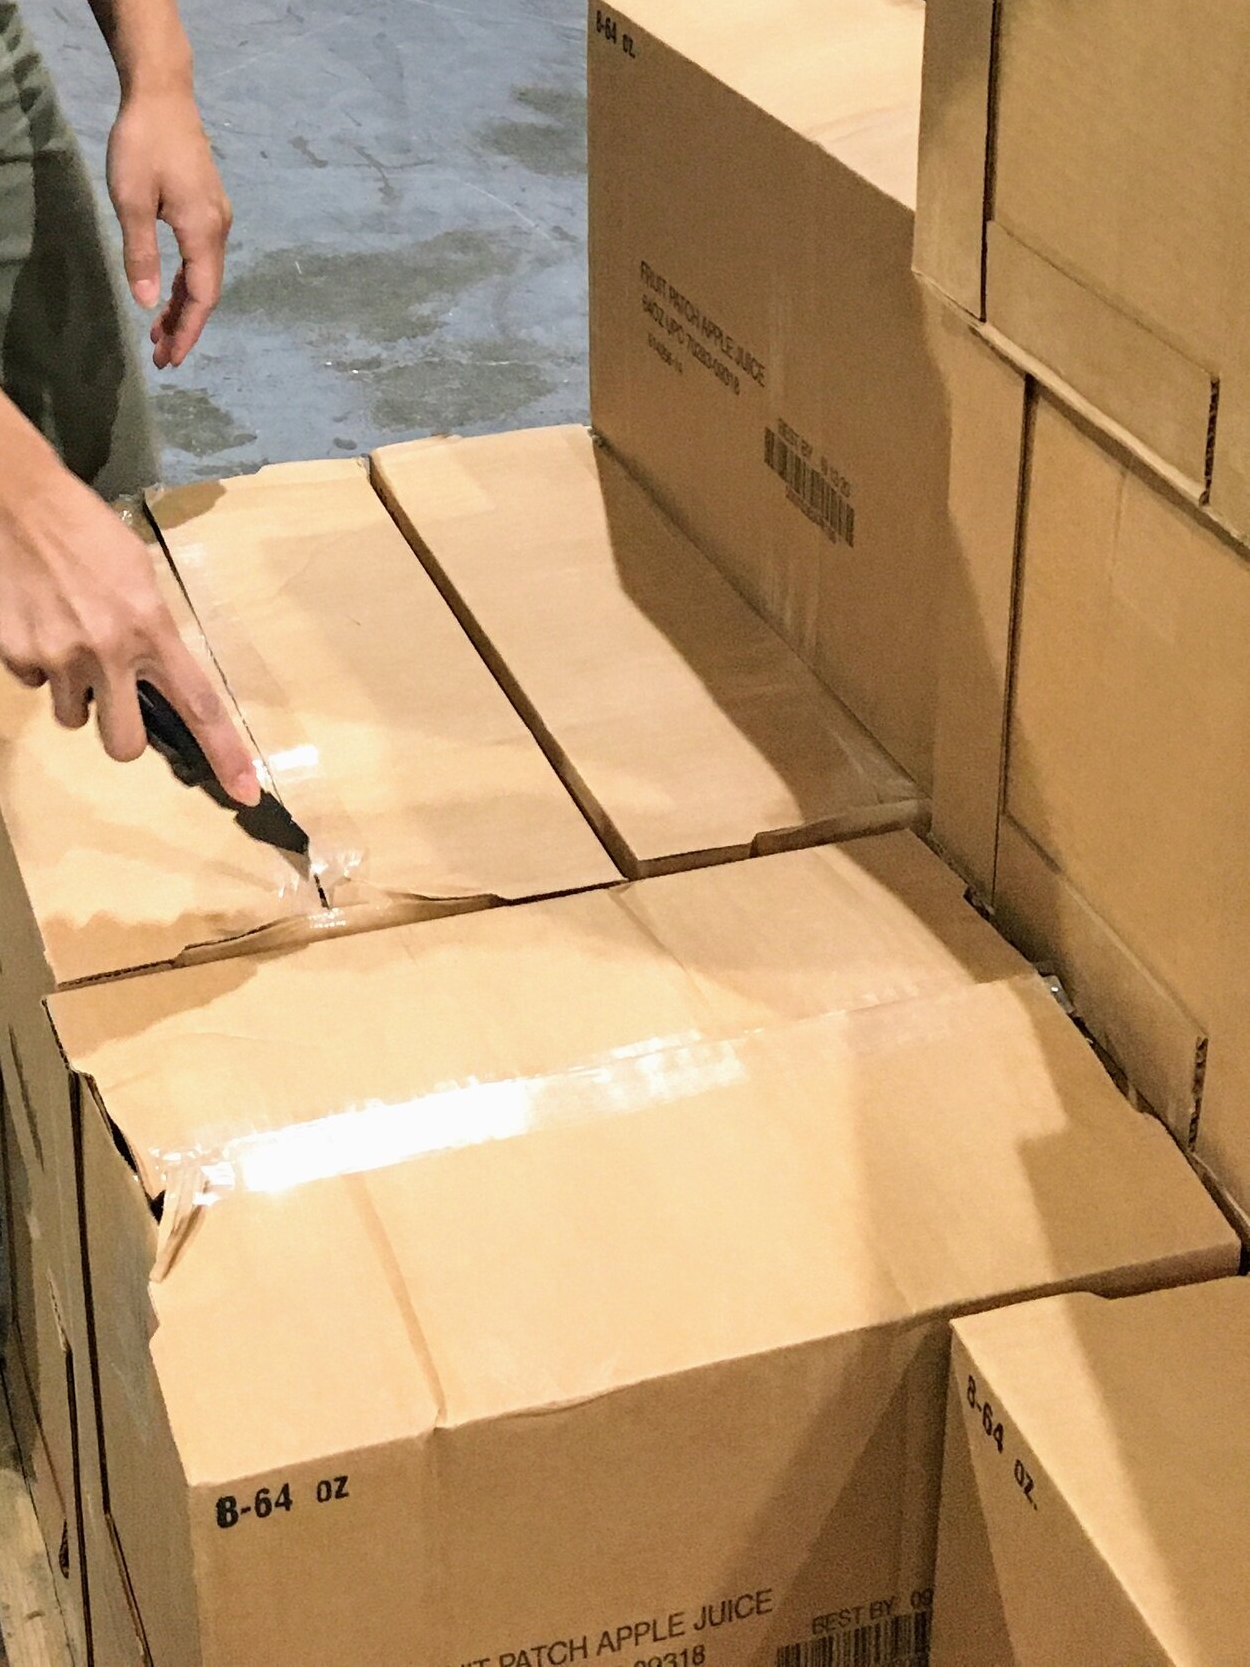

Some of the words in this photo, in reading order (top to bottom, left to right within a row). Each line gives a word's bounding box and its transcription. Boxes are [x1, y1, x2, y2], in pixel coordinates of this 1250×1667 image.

[701, 315, 734, 361] APPLE
[734, 345, 766, 388] JUICE
[966, 1374, 1004, 1454] 8-64
[215, 1482, 294, 1529] 8-64
[498, 1635, 588, 1667] PATCH
[596, 1612, 687, 1656] APPLE
[692, 1588, 774, 1632] JUICE
[812, 1605, 865, 1635] BEST
[869, 1595, 896, 1621] BY
